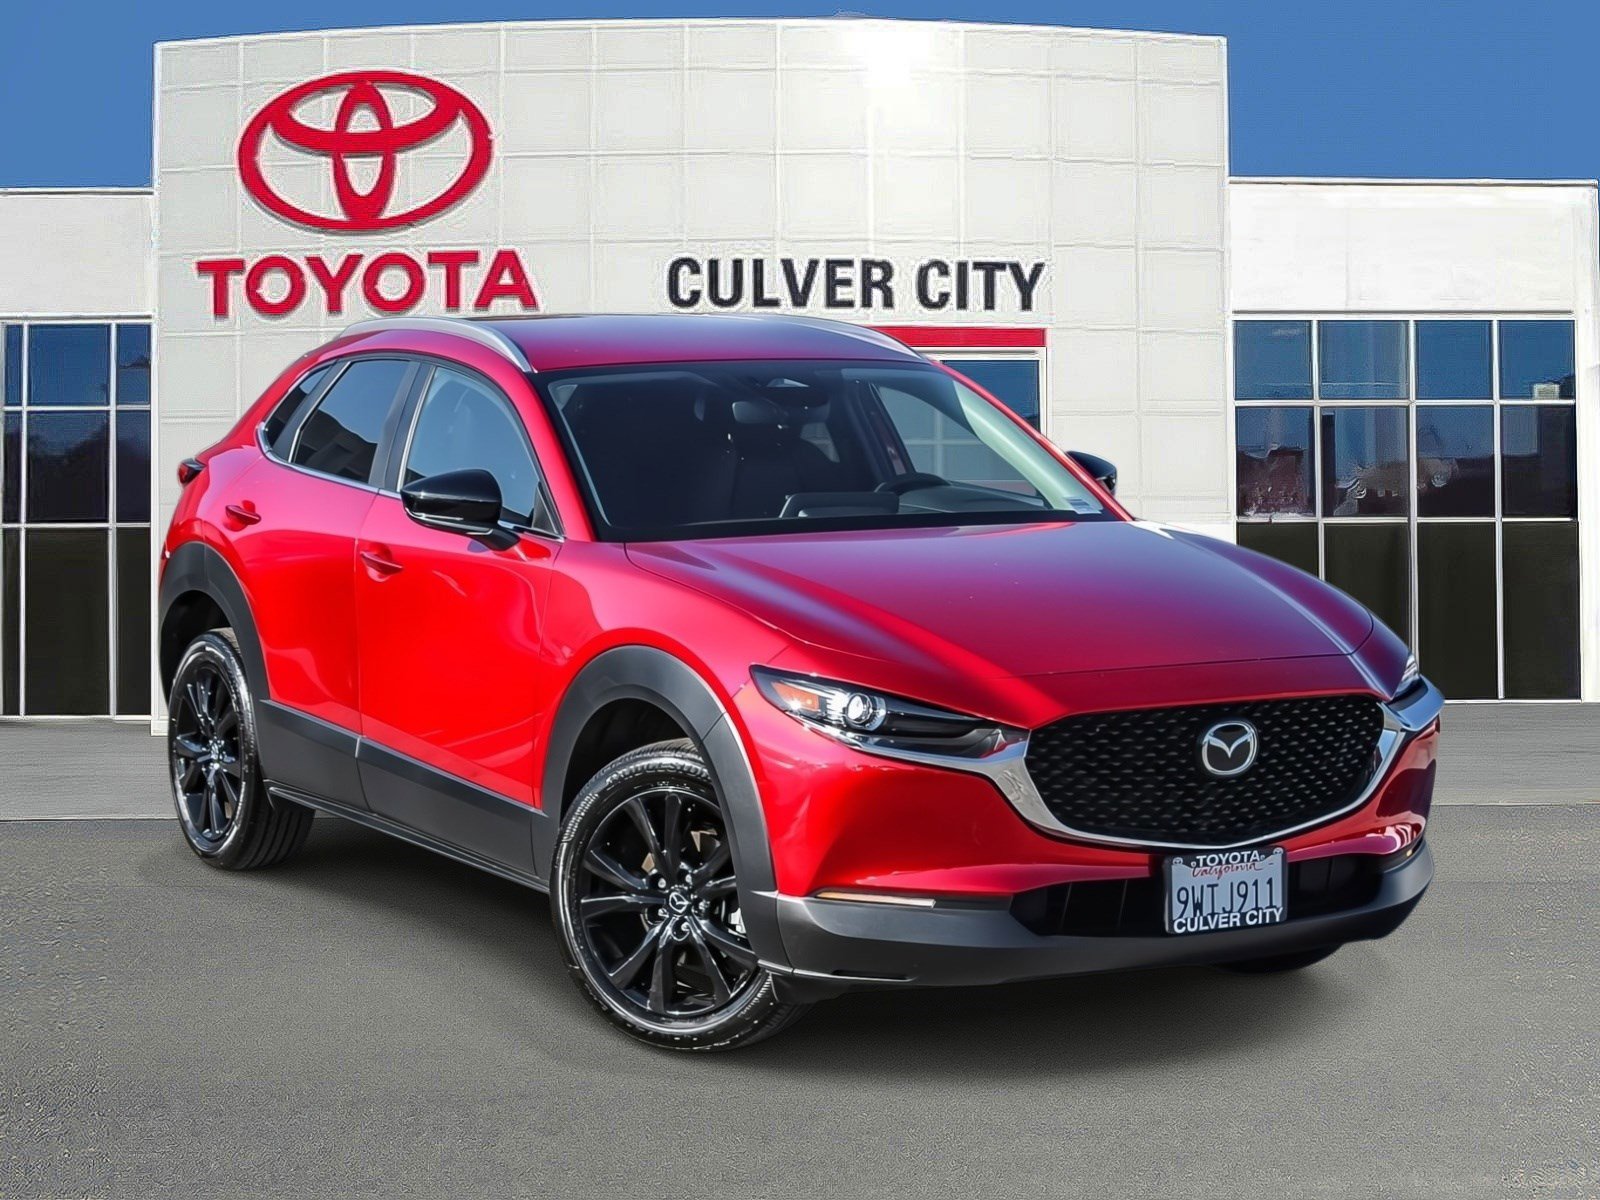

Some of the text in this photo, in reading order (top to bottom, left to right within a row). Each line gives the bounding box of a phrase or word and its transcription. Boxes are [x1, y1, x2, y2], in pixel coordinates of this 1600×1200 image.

[196, 250, 538, 318] TOYOTA
[668, 257, 1045, 311] CULVER CITY
[1196, 850, 1261, 867] TOYOTA
[1176, 877, 1274, 919] 9WTJ911
[1173, 907, 1283, 933] CULVER CITY
